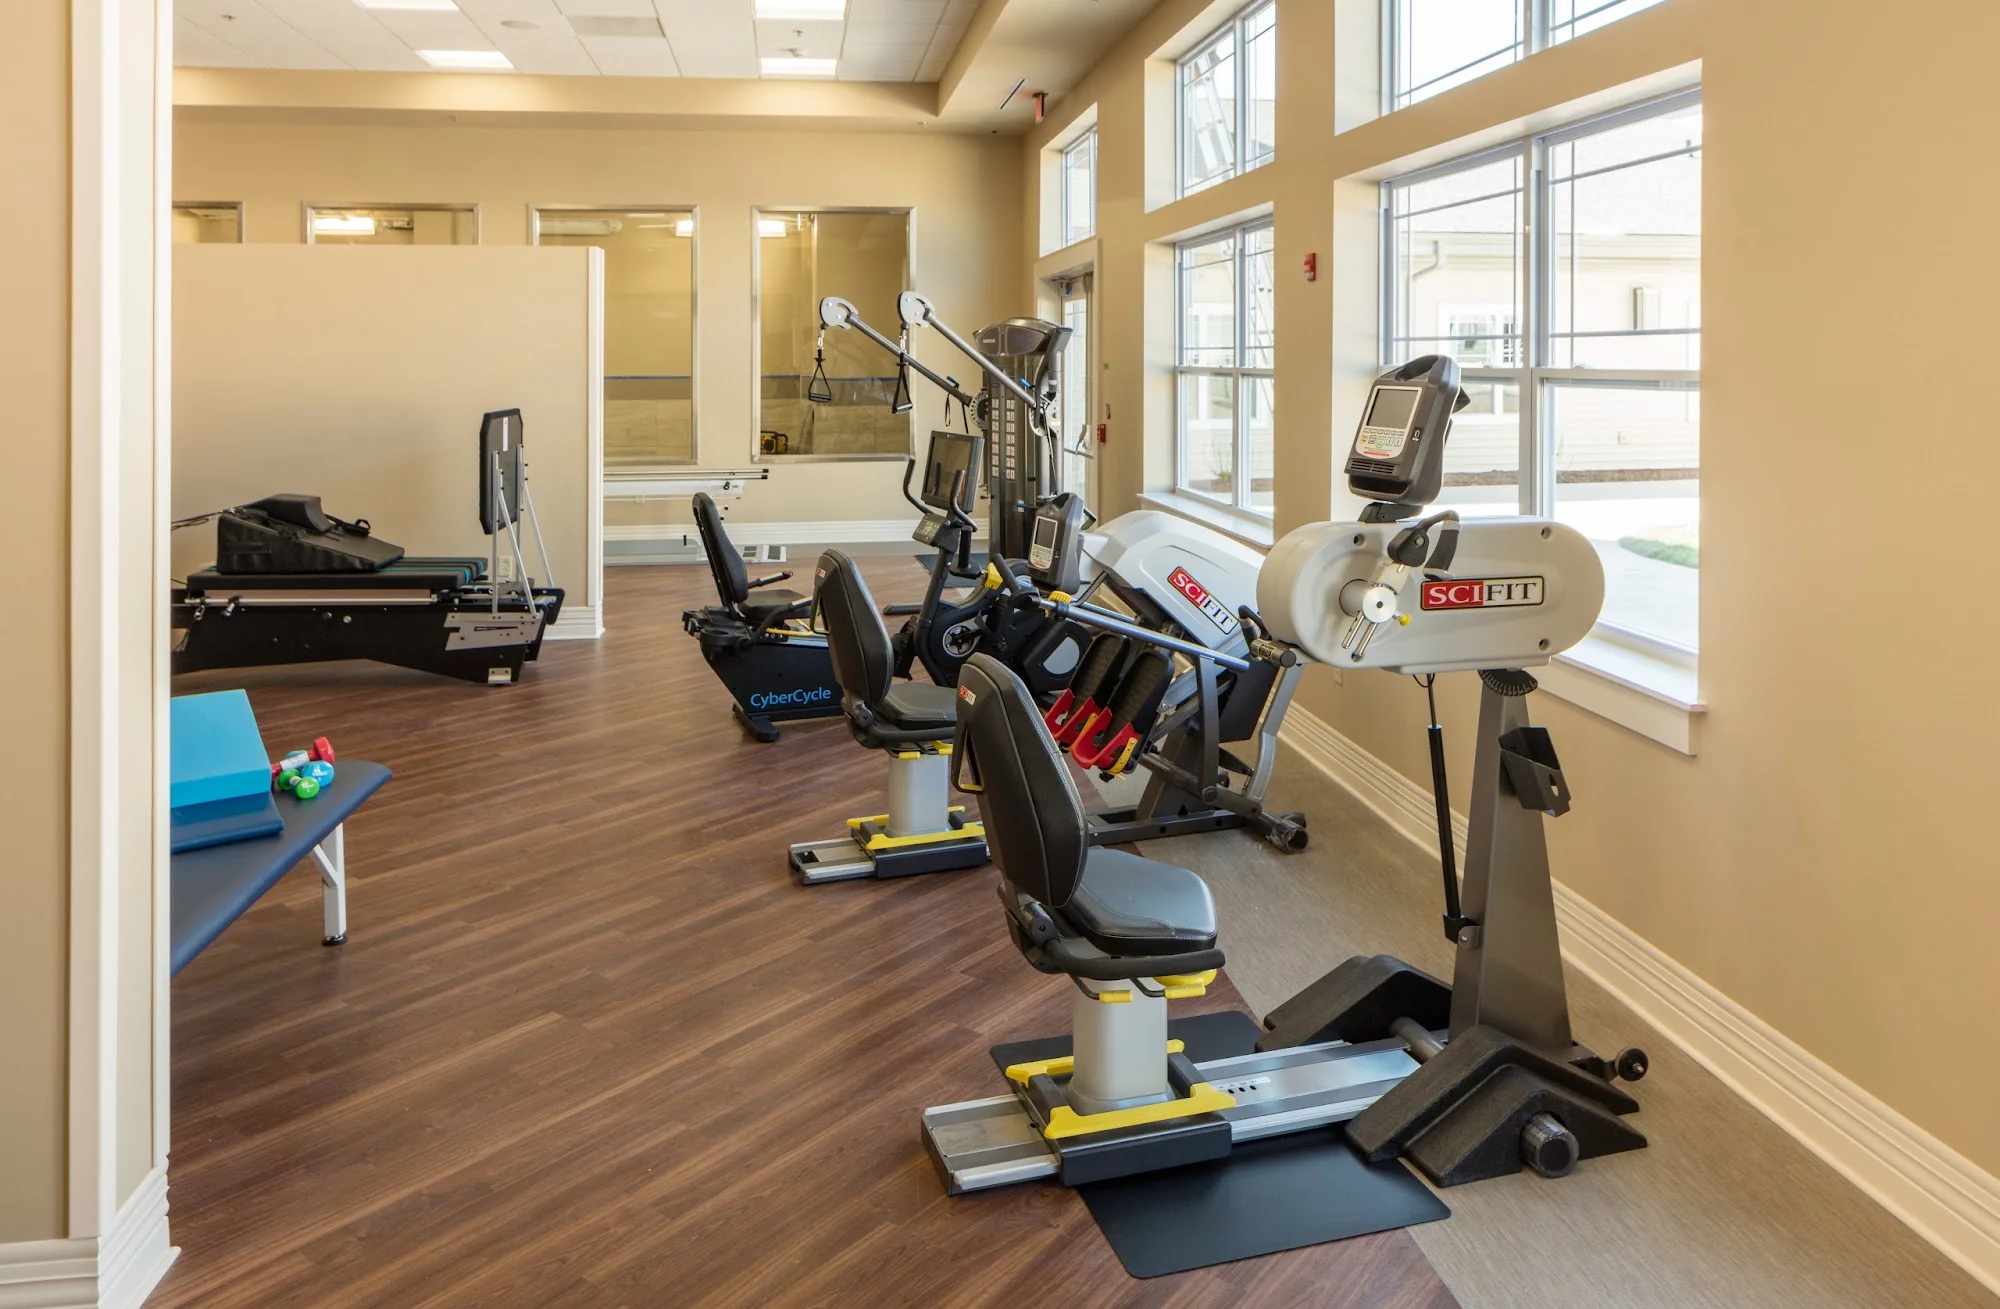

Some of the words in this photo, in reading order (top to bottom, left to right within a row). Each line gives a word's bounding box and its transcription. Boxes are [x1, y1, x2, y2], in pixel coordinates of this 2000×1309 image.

[1173, 573, 1233, 626] SCIFIT
[1428, 582, 1537, 605] SCIFIT
[750, 686, 832, 708] CyberCycle
